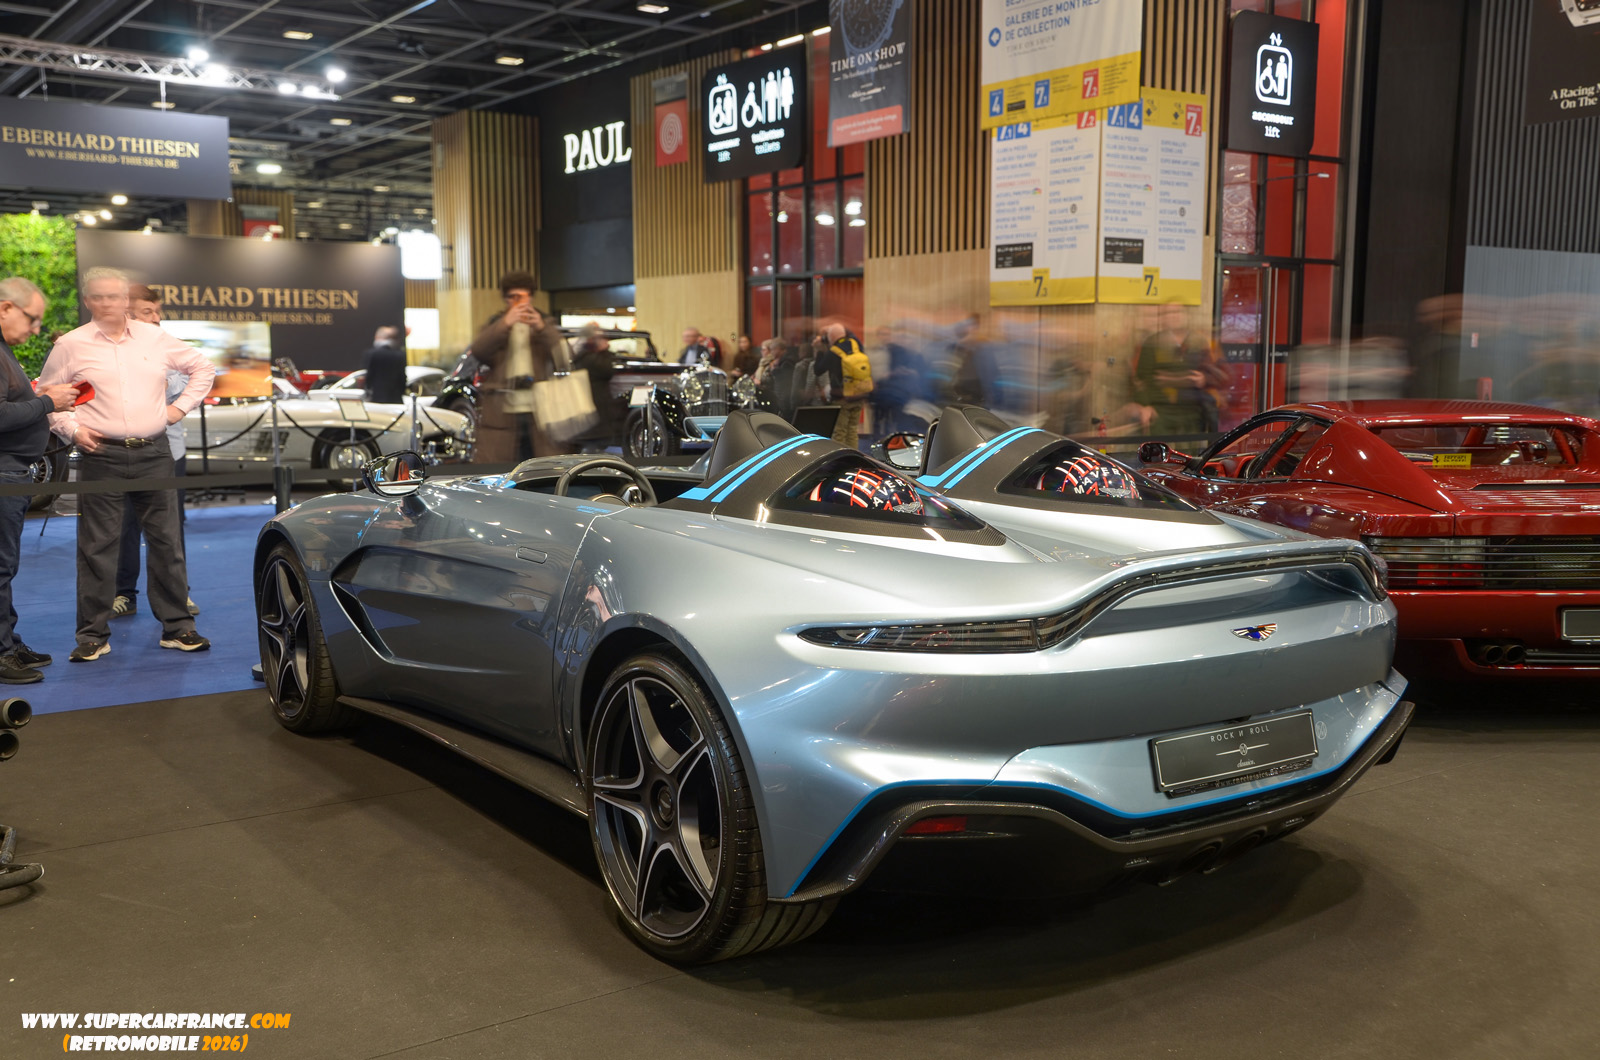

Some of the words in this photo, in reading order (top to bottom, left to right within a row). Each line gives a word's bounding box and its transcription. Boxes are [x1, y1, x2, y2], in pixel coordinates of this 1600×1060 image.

[1005, 8, 1040, 26] GALERIE
[1042, 5, 1053, 18] DE
[1005, 30, 1015, 41] DE
[1017, 16, 1070, 38] COLLECTION
[831, 56, 856, 73] TIME
[857, 52, 872, 65] ON
[874, 42, 906, 62] SHOW
[1550, 90, 1558, 100] A
[1560, 86, 1595, 98] Racing
[1560, 99, 1576, 109] On
[1578, 96, 1598, 107] The
[992, 96, 1001, 114] 4
[1129, 105, 1140, 126] 4
[1187, 112, 1201, 135] 7.2
[1264, 126, 1280, 138] lift
[2, 126, 115, 152] EBERHARD
[117, 136, 200, 158] THIESEN
[563, 121, 632, 174] PAUL
[26, 148, 180, 169] WWW.EBERHARD-THIESEN.DE
[257, 288, 359, 310] THIESEN
[1211, 732, 1235, 742] ROCK
[1250, 725, 1270, 735] ROLL
